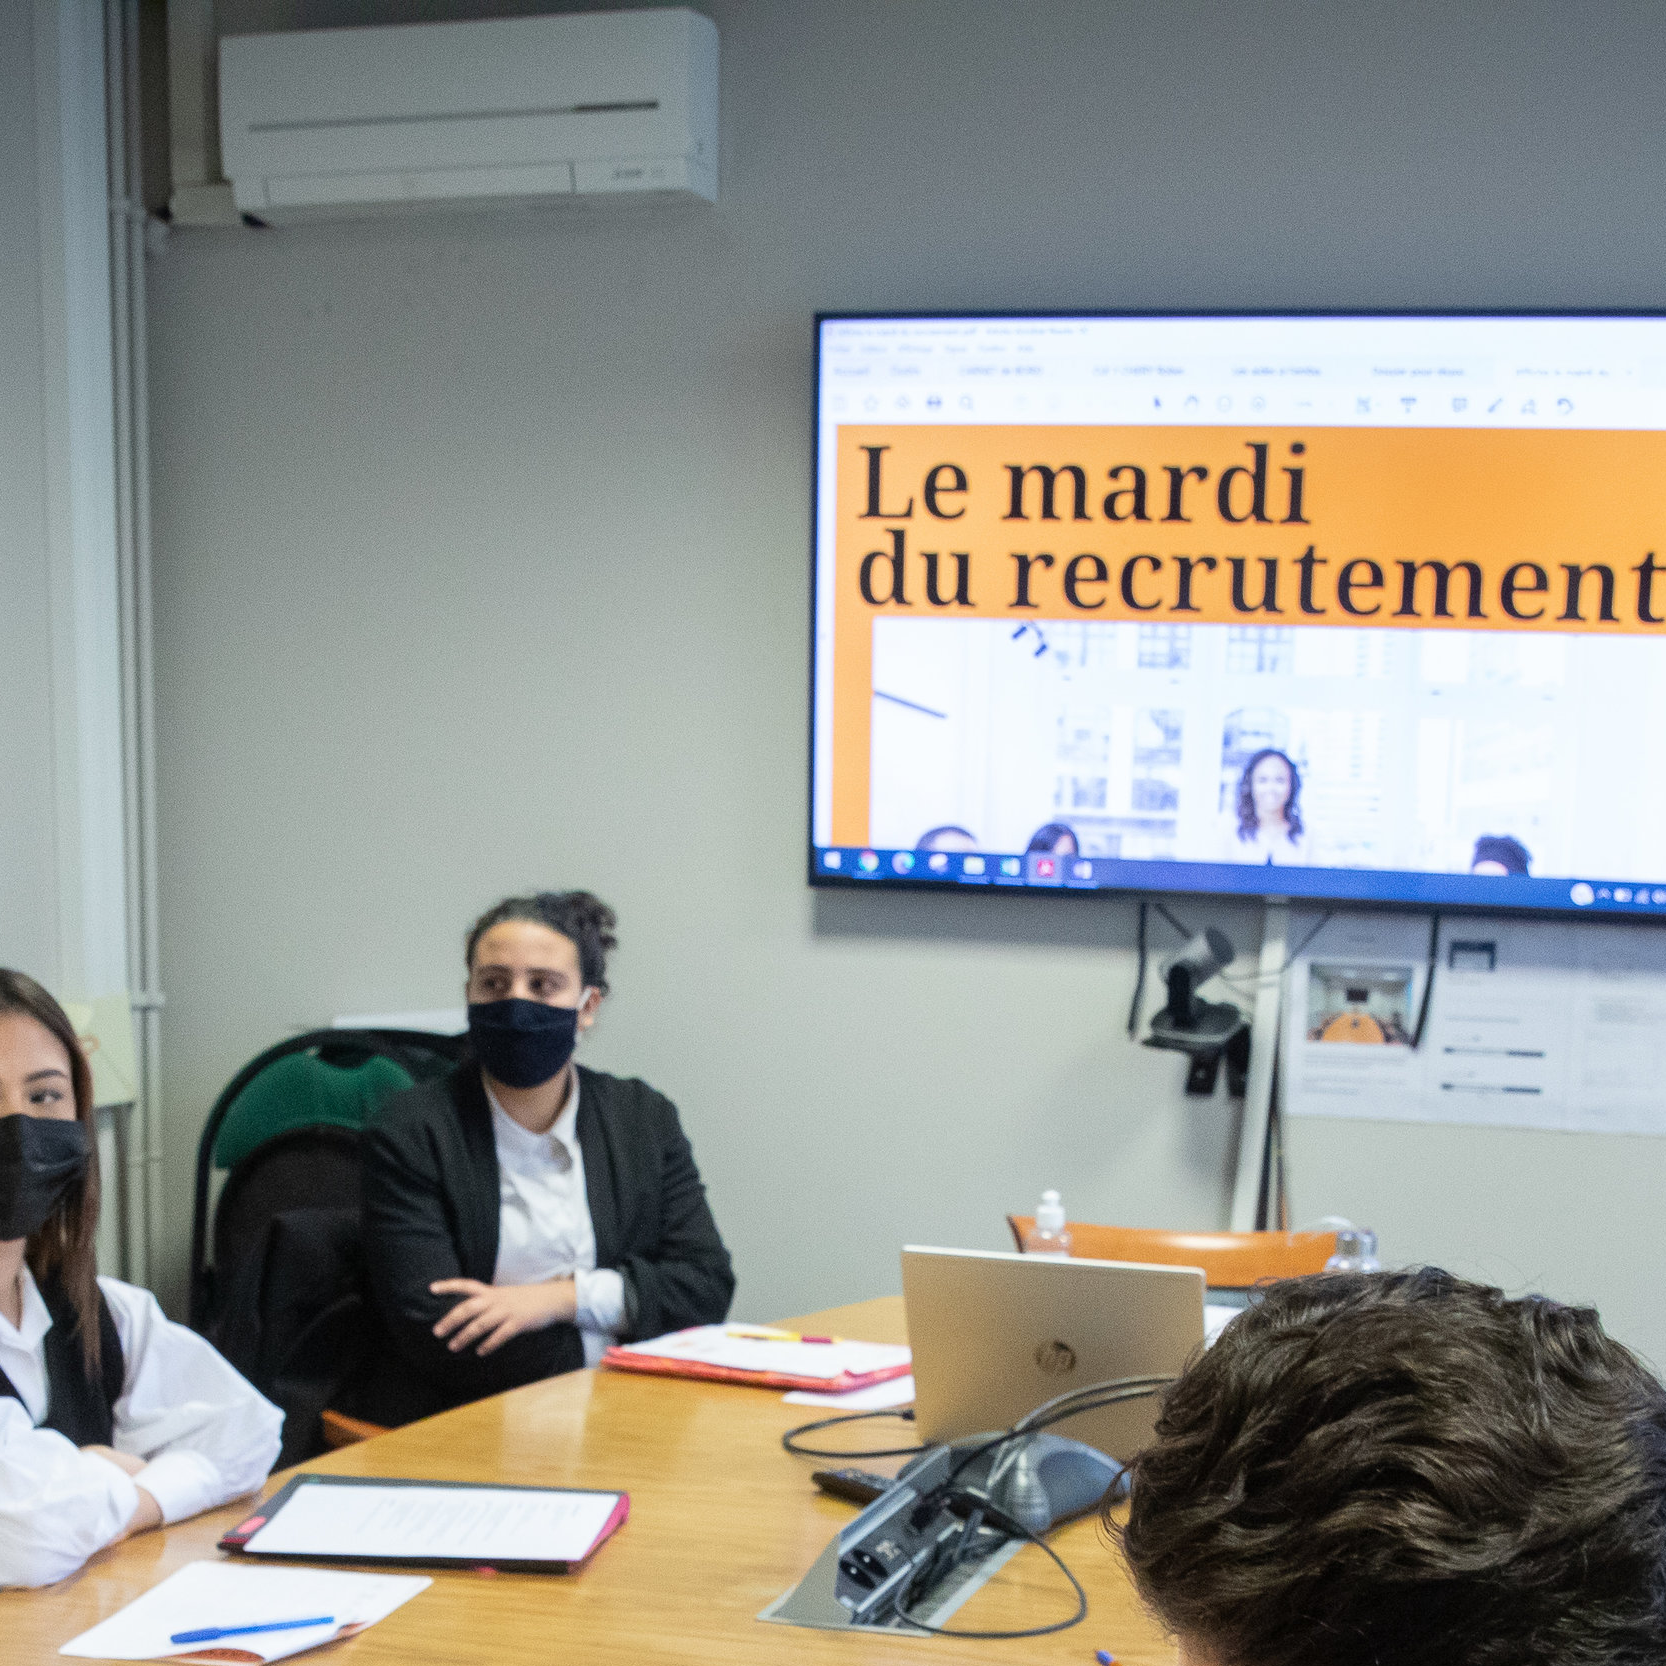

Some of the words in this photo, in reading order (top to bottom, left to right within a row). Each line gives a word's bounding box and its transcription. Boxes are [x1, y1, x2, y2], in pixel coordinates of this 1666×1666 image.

[856, 445, 969, 524] Le
[1003, 441, 1312, 526] mardi
[859, 527, 976, 609] du
